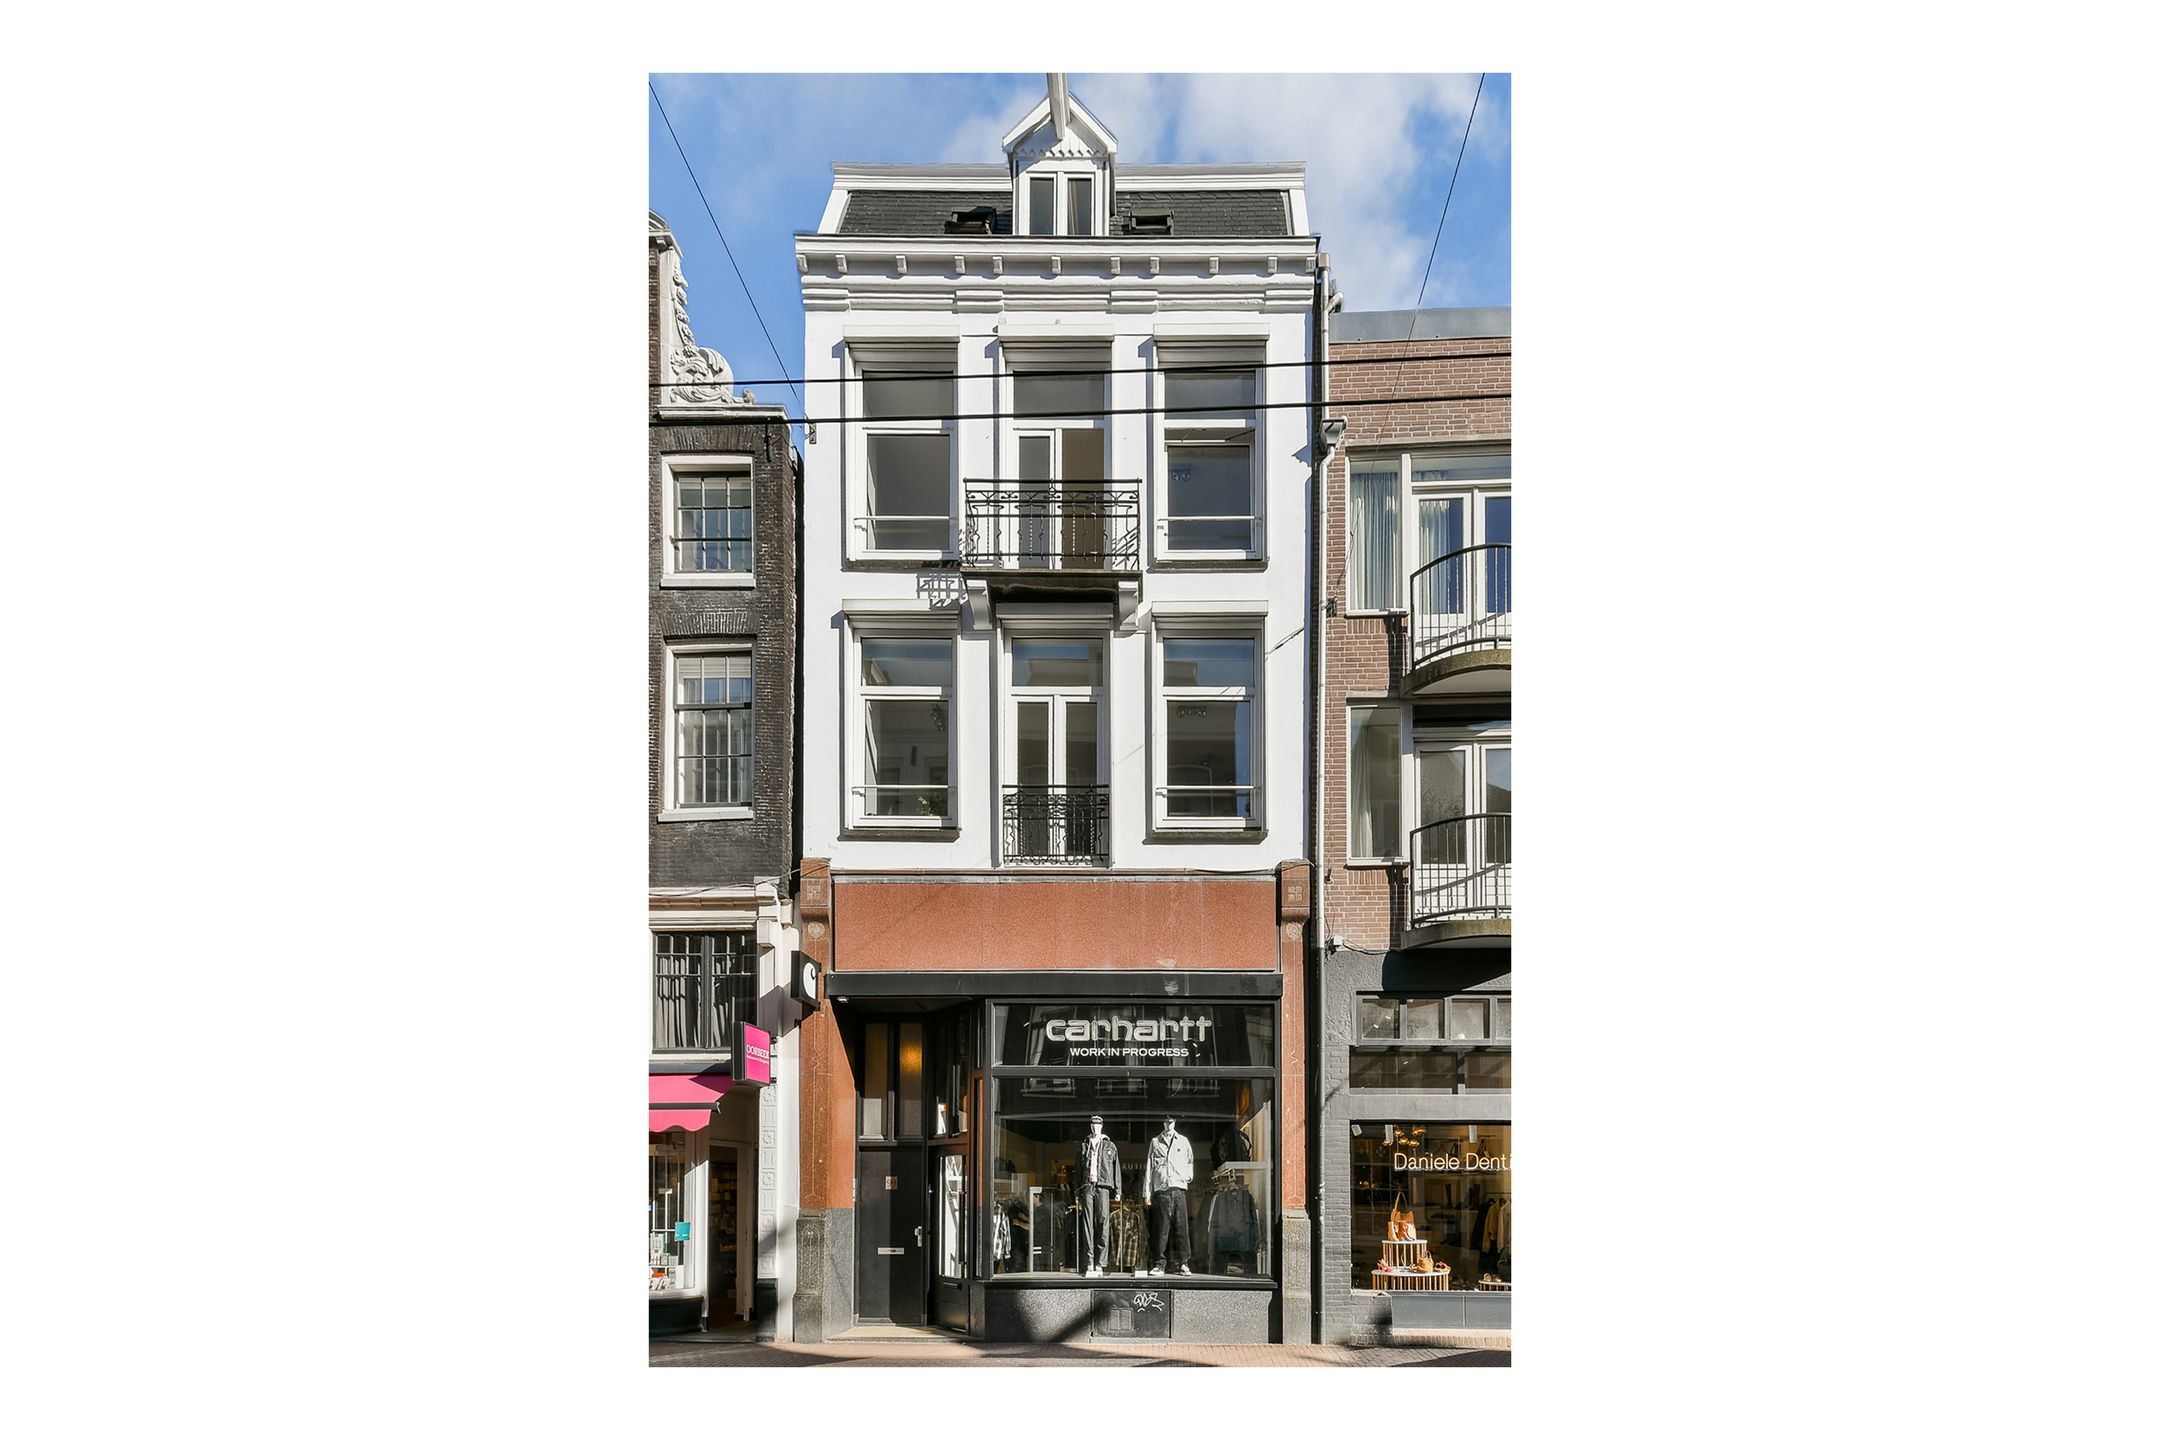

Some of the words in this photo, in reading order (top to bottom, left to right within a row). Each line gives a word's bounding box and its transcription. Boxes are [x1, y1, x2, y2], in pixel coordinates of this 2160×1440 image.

[1046, 1015, 1212, 1042] carhartt
[1069, 1047, 1107, 1057] WORK
[1108, 1047, 1119, 1057] IN
[1122, 1047, 1189, 1057] PROGRESS
[1394, 1152, 1460, 1170] Daniele
